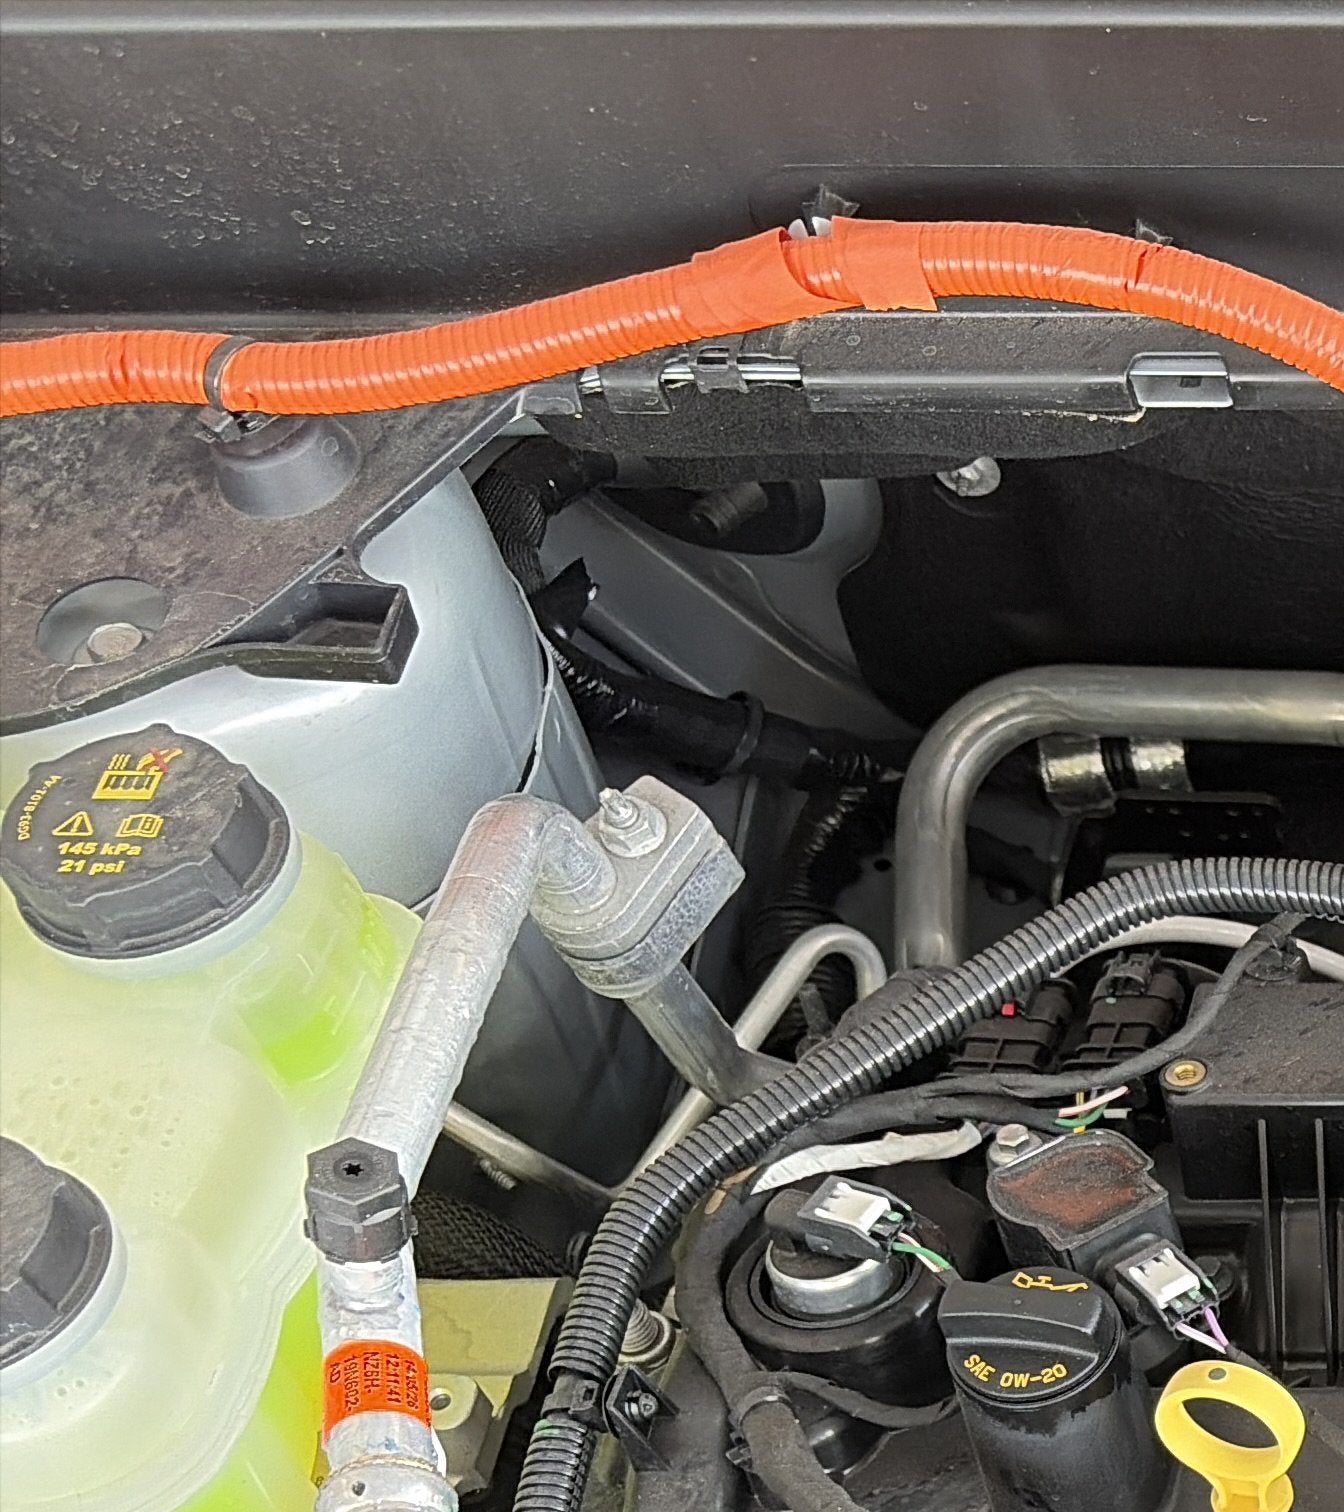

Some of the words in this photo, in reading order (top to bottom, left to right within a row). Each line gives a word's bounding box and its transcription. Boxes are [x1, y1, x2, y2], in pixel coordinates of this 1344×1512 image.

[57, 841, 98, 855] 145
[100, 842, 142, 856] kPa
[56, 859, 87, 873] 21
[88, 860, 126, 876] psi
[963, 1354, 996, 1382] SAE
[999, 1362, 1068, 1388] 0W-20
